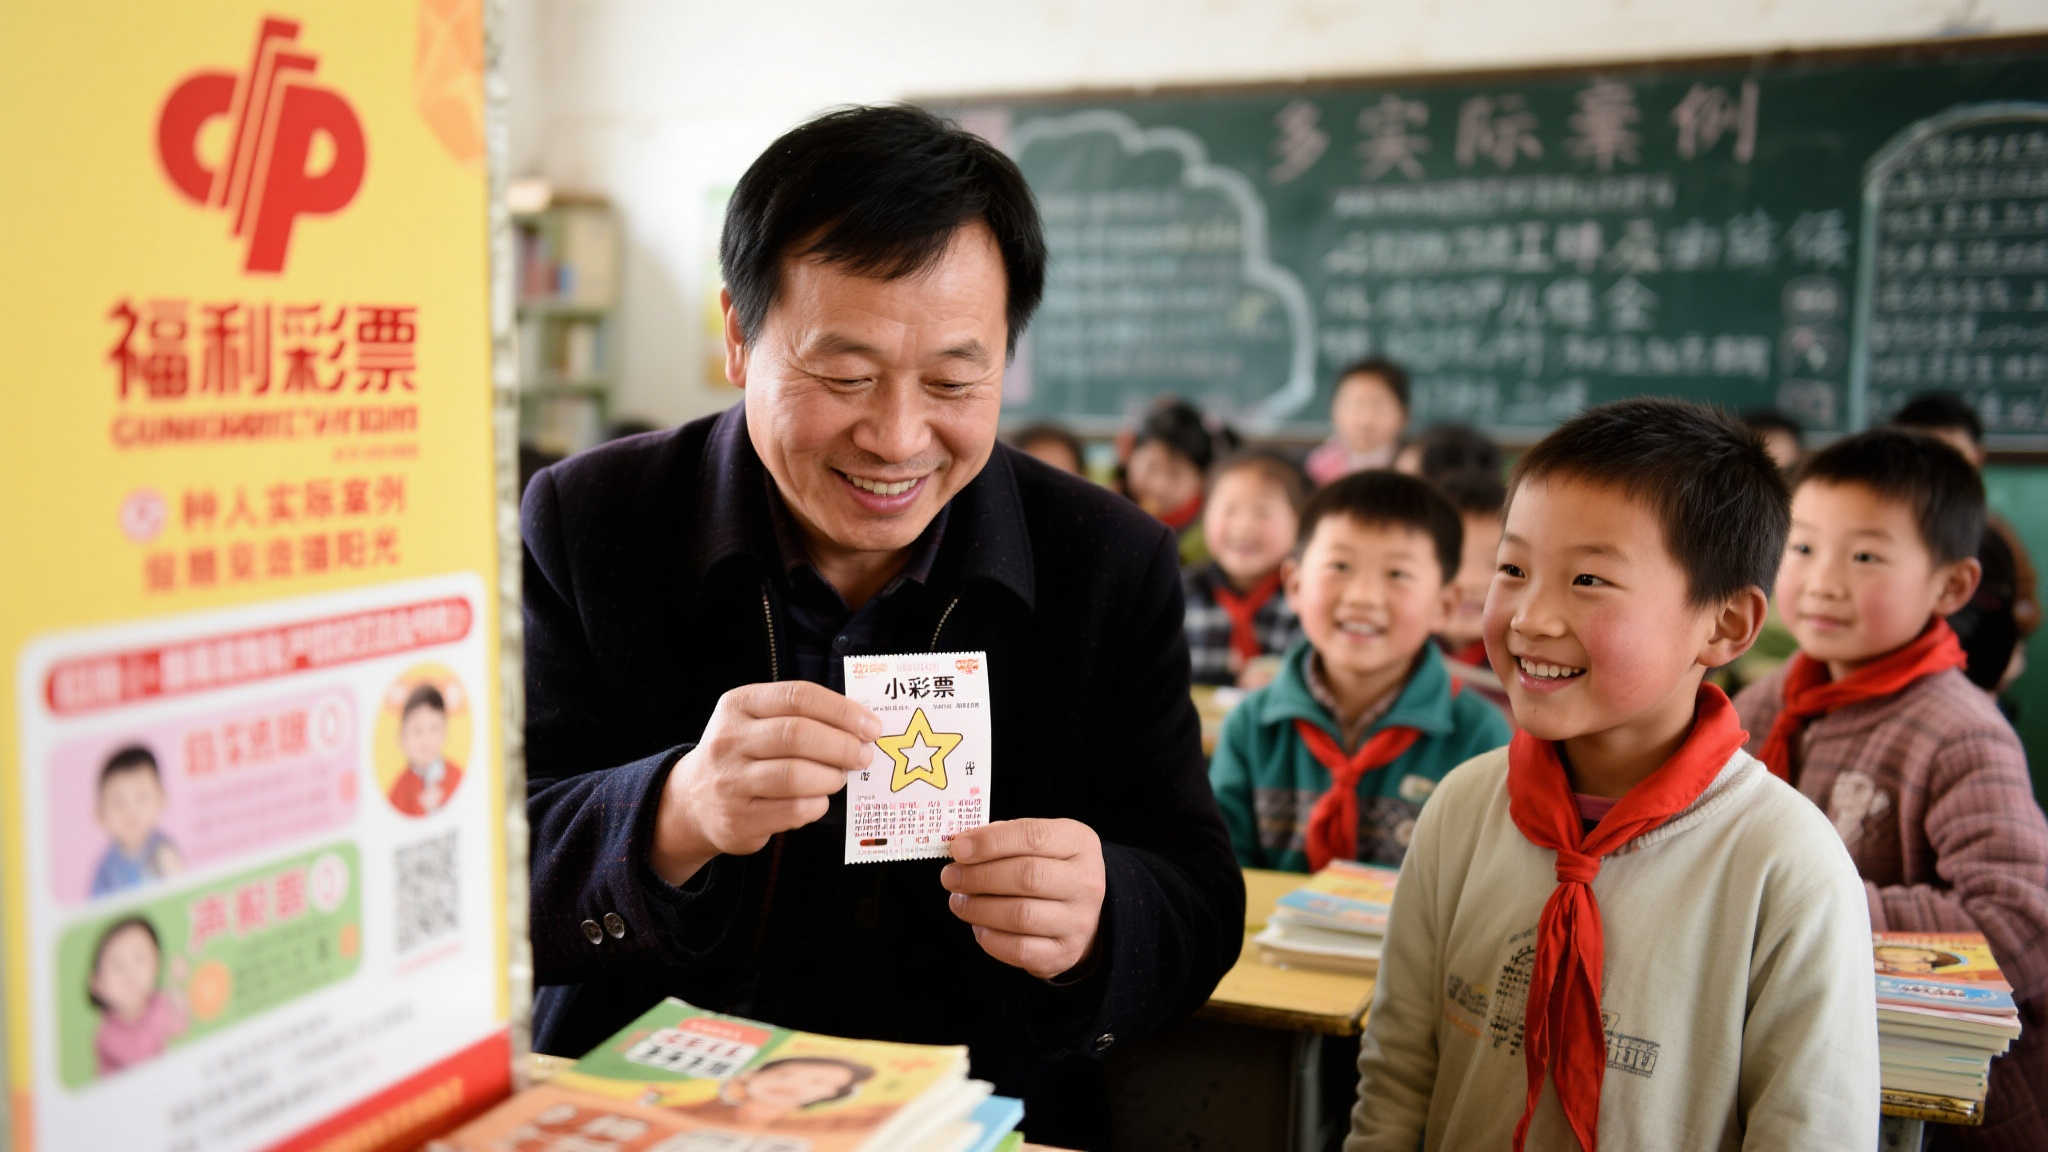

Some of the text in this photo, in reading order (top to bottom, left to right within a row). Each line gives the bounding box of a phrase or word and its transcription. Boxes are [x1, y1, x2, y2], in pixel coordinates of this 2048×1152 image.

[107, 298, 418, 400] 福利彩票
[885, 675, 956, 700] 小彩票
